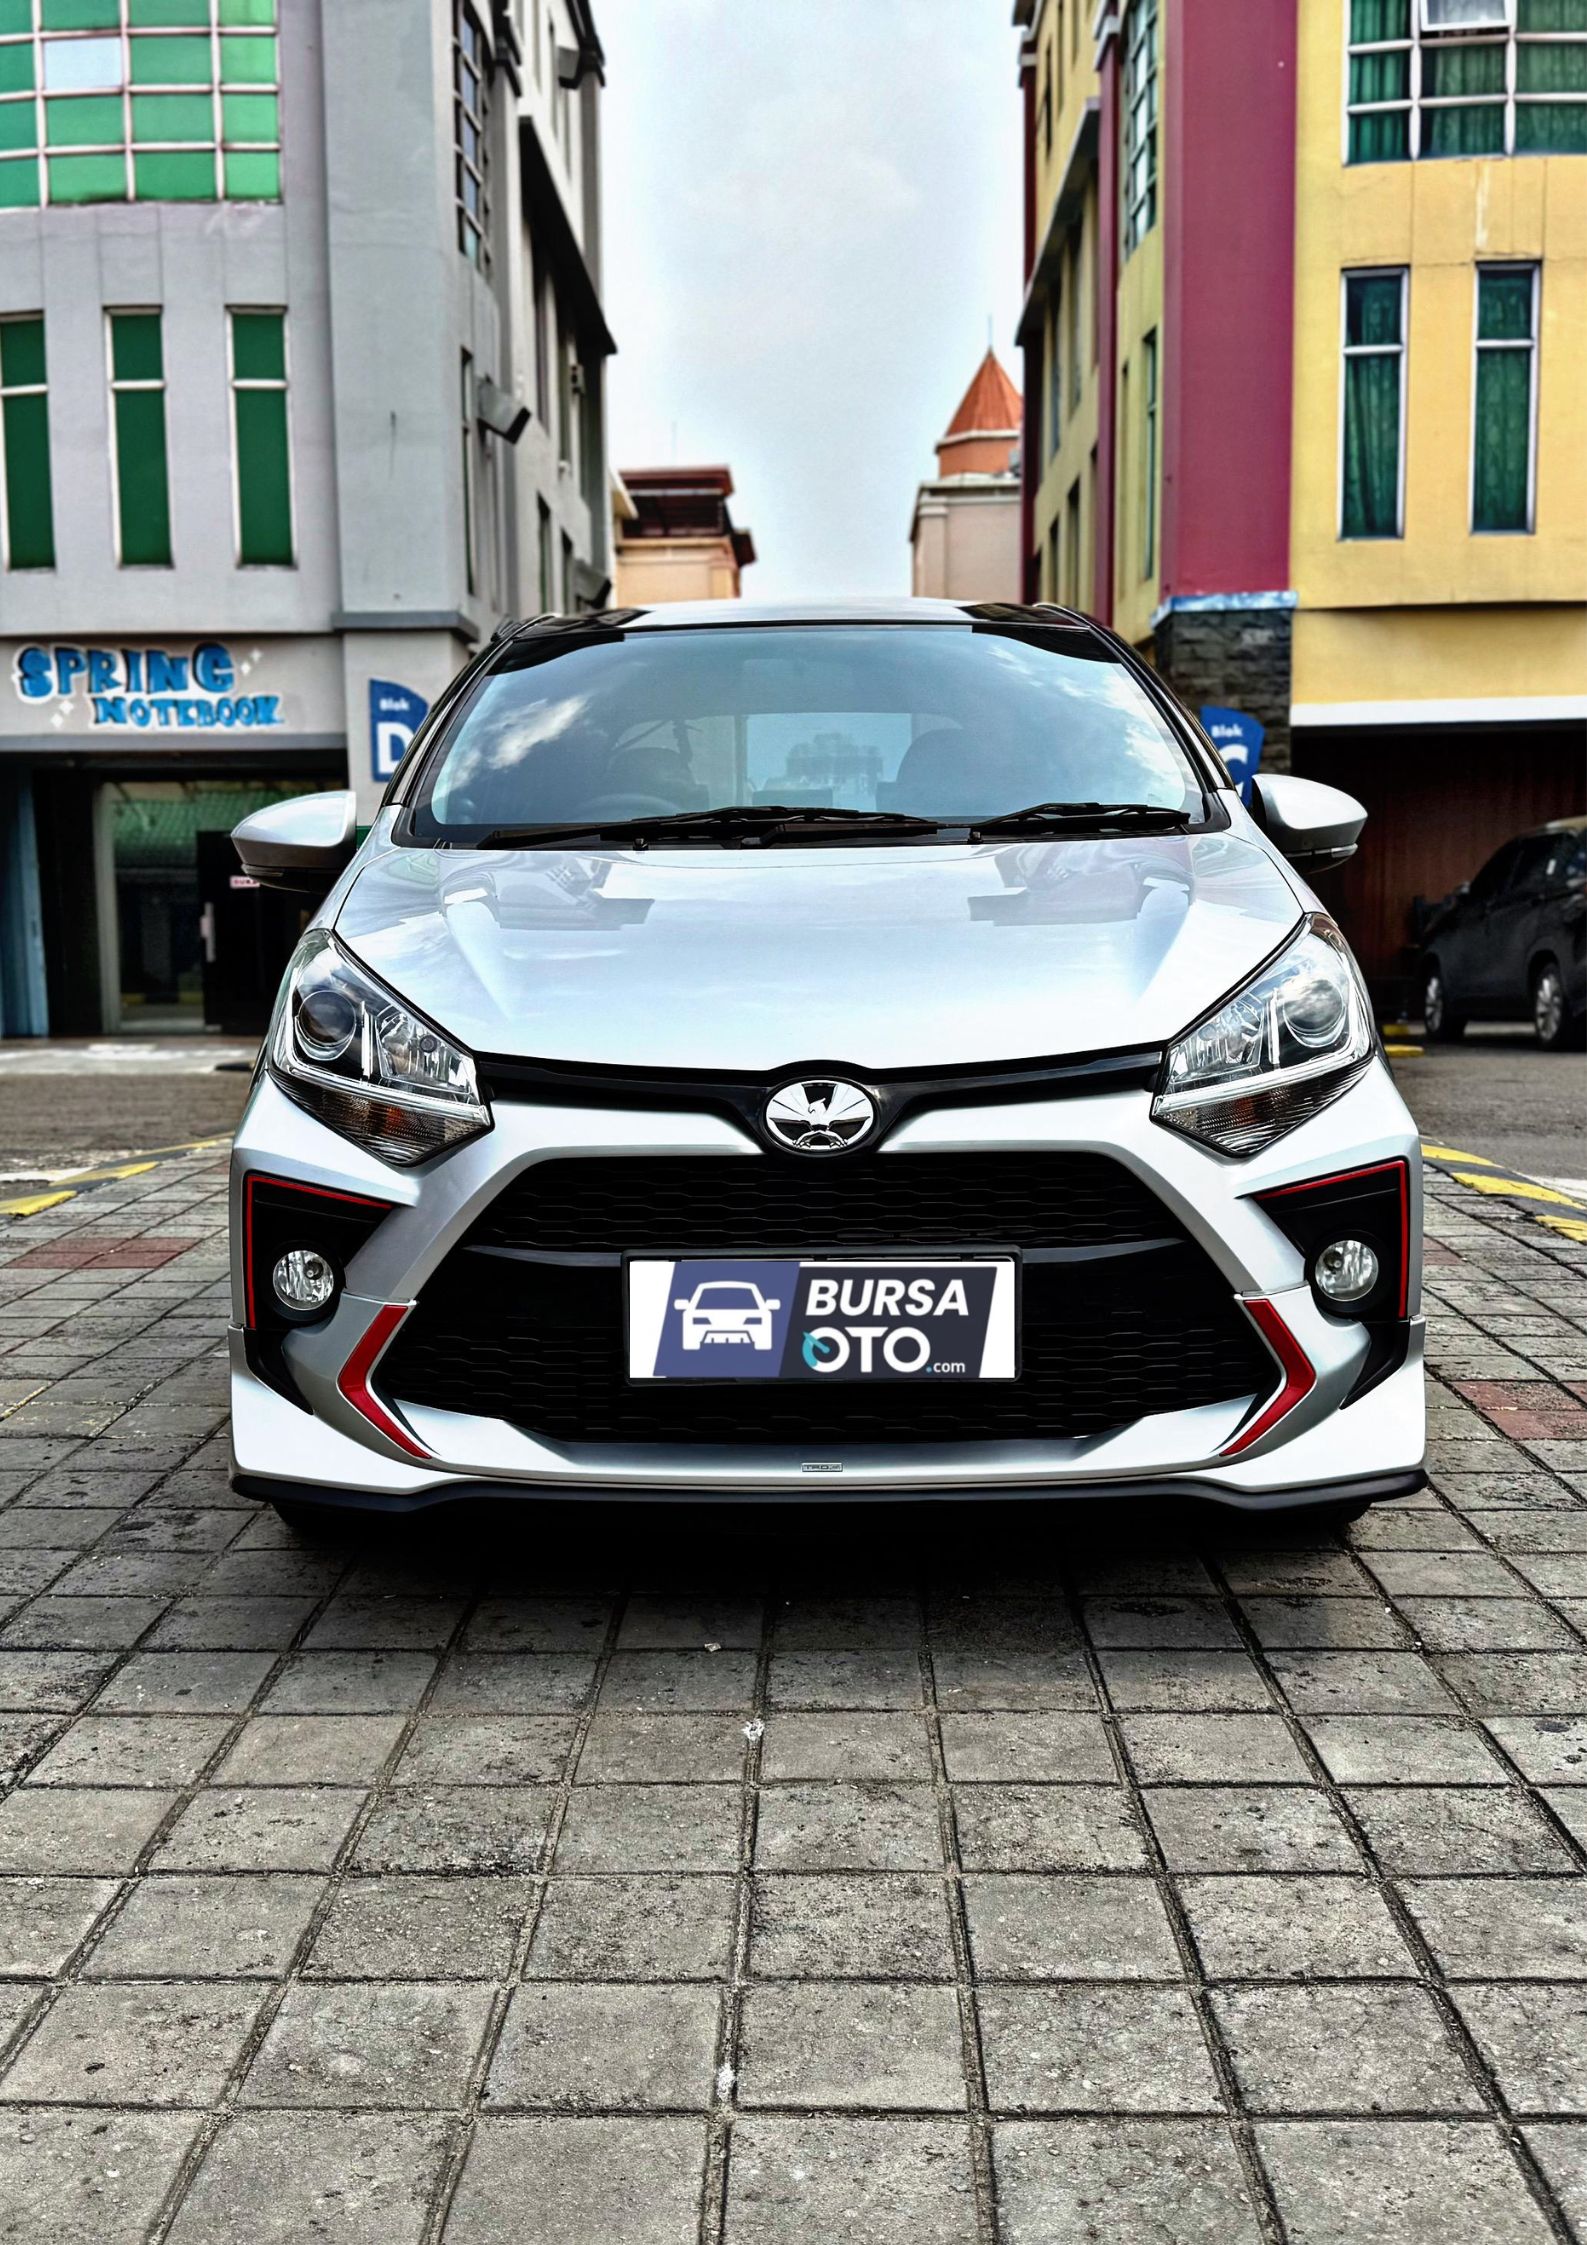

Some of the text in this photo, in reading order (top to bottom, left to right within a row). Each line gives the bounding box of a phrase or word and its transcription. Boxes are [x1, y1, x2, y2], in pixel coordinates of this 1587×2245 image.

[18, 643, 235, 698] SPRING
[94, 696, 284, 727] NOTEBOOK
[377, 721, 415, 774] D
